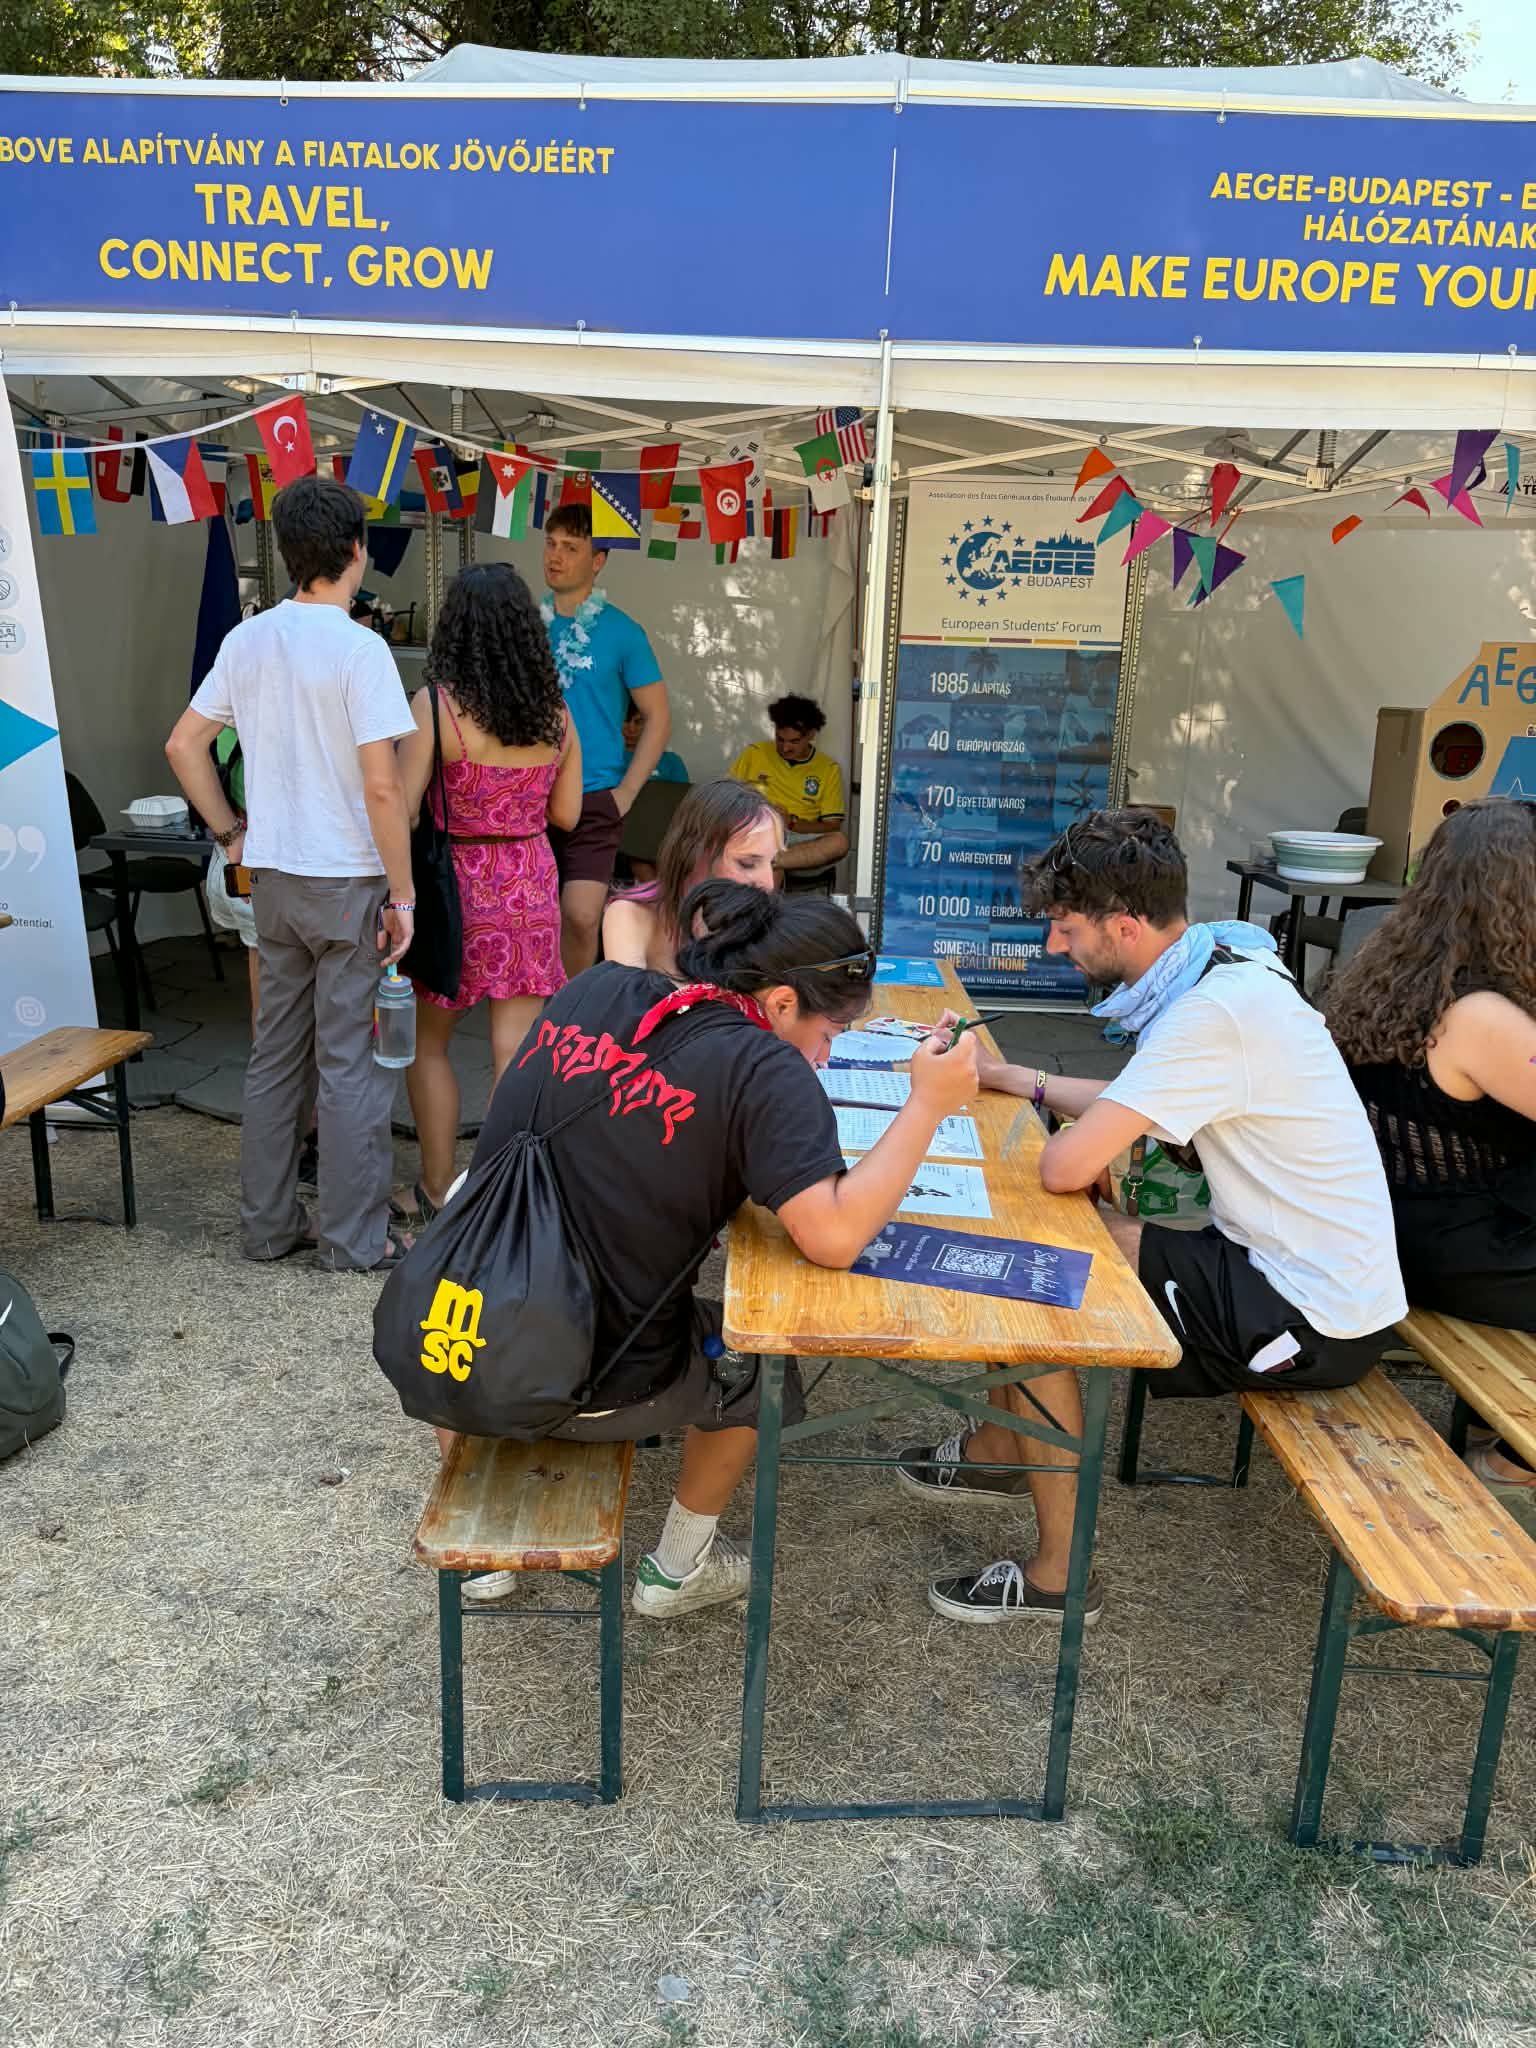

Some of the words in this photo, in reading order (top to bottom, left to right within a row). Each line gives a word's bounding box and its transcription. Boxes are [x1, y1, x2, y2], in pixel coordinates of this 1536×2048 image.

[82, 132, 265, 167] ALAPÍTVÁNY
[275, 140, 296, 167] A
[303, 141, 441, 171] FIATALOK
[448, 139, 615, 174] JÖVŐJÉÉRT
[1210, 172, 1491, 208] AEGEE-BUDAPEST
[195, 183, 391, 232] TRAVEL,
[1303, 209, 1536, 249] HÁLÓZATÁNAK
[99, 238, 333, 288] CONNECT,
[347, 245, 494, 290] GROW
[1044, 254, 1190, 298] MAKE
[1203, 258, 1399, 305] EUROPE
[990, 550, 1095, 576] AEGEE
[1027, 576, 1094, 589] BUDAPEST
[941, 618, 999, 632] European
[1002, 620, 1060, 632] Students'
[1062, 622, 1102, 633] Forum
[930, 672, 969, 694] 1985
[928, 730, 949, 751] 40
[927, 785, 955, 807] 170
[957, 796, 996, 809] EGYETEMI
[921, 841, 942, 862] 70
[974, 852, 1012, 865] EGYETEM
[918, 895, 935, 916] 10
[939, 896, 970, 917] 000
[975, 905, 990, 917] TAG
[12, 917, 54, 929] otential.
